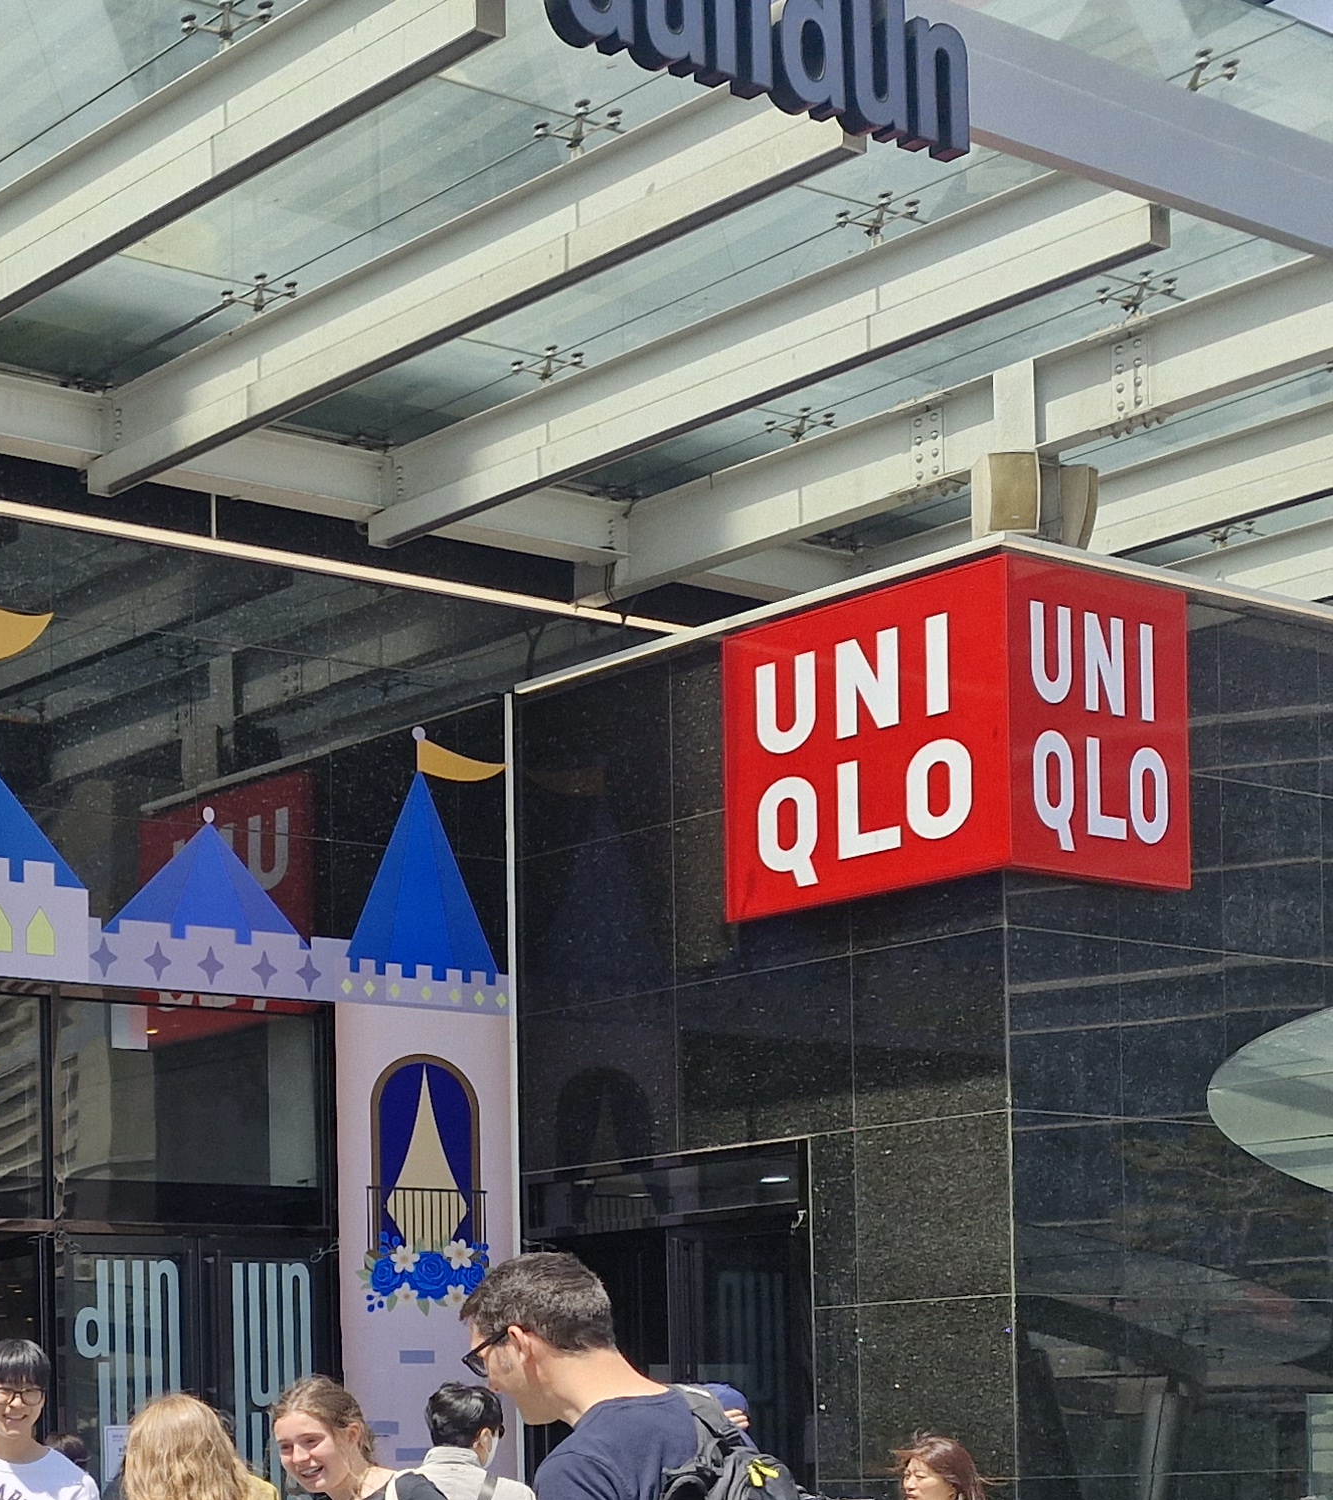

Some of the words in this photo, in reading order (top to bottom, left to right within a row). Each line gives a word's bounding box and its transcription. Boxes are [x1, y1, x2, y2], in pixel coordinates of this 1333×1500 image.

[755, 612, 950, 754] UNI
[1029, 600, 1155, 722] UNI
[758, 738, 972, 887] QLO
[1032, 730, 1168, 851] QLO
